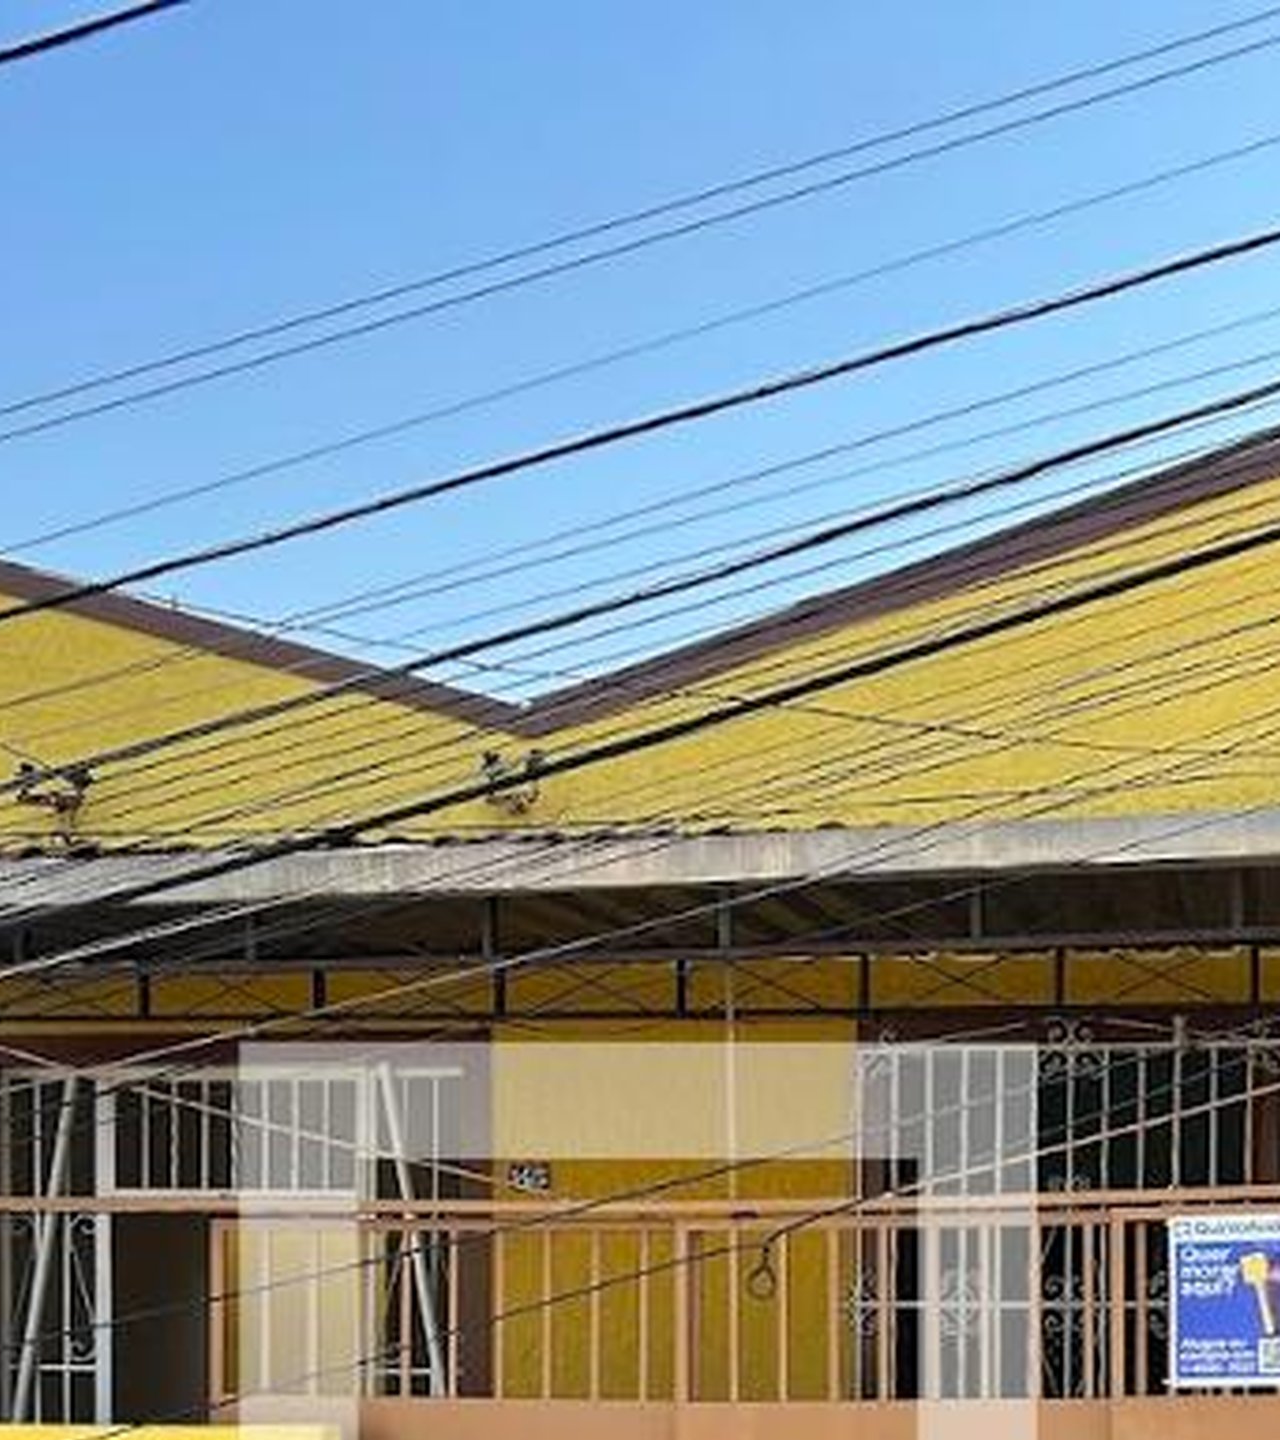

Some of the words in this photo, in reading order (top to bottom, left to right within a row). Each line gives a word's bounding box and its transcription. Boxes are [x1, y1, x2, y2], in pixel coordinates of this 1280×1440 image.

[1180, 1247, 1233, 1263] Quer
[1180, 1264, 1240, 1279] morar
[1180, 1281, 1236, 1298] aqui?
